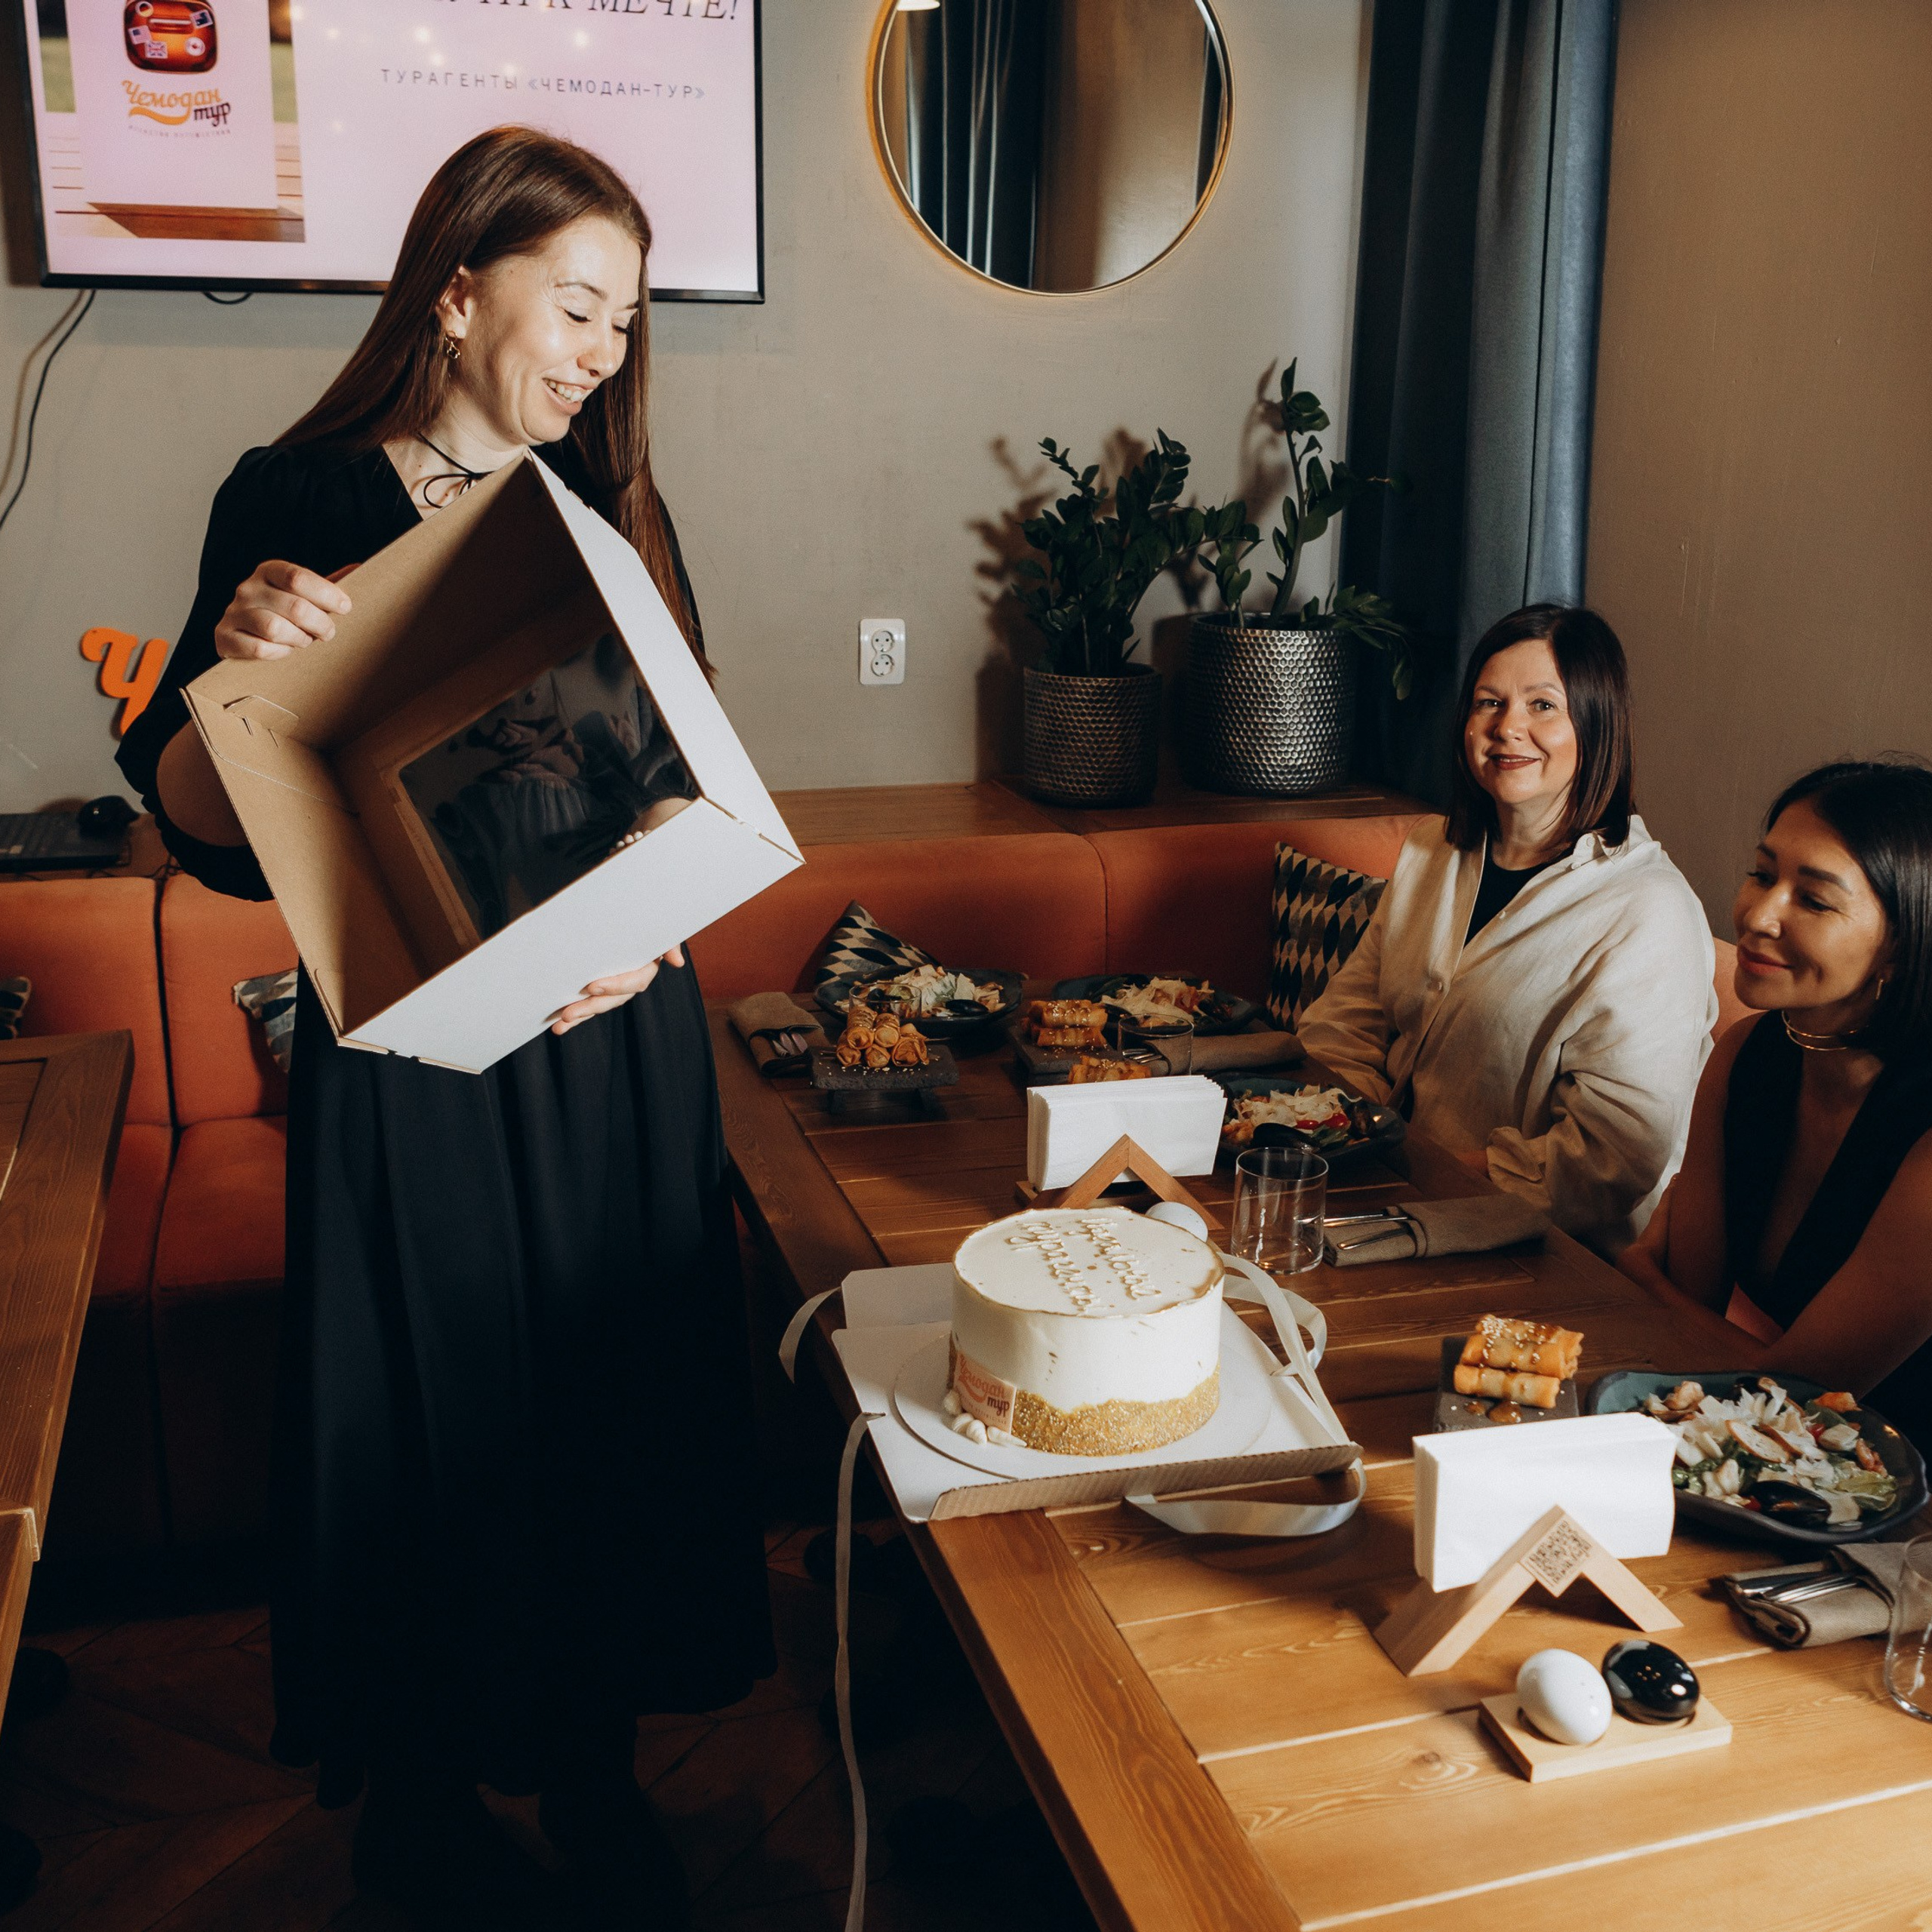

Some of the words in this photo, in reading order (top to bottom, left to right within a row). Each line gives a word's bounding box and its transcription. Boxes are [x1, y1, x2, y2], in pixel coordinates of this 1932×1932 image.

[380, 69, 518, 89] ТУРАГЕНТЫ
[528, 78, 705, 99] «ЧЕМОДАН-ТУР»
[193, 103, 231, 127] тур
[987, 1395, 1011, 1417] тур
